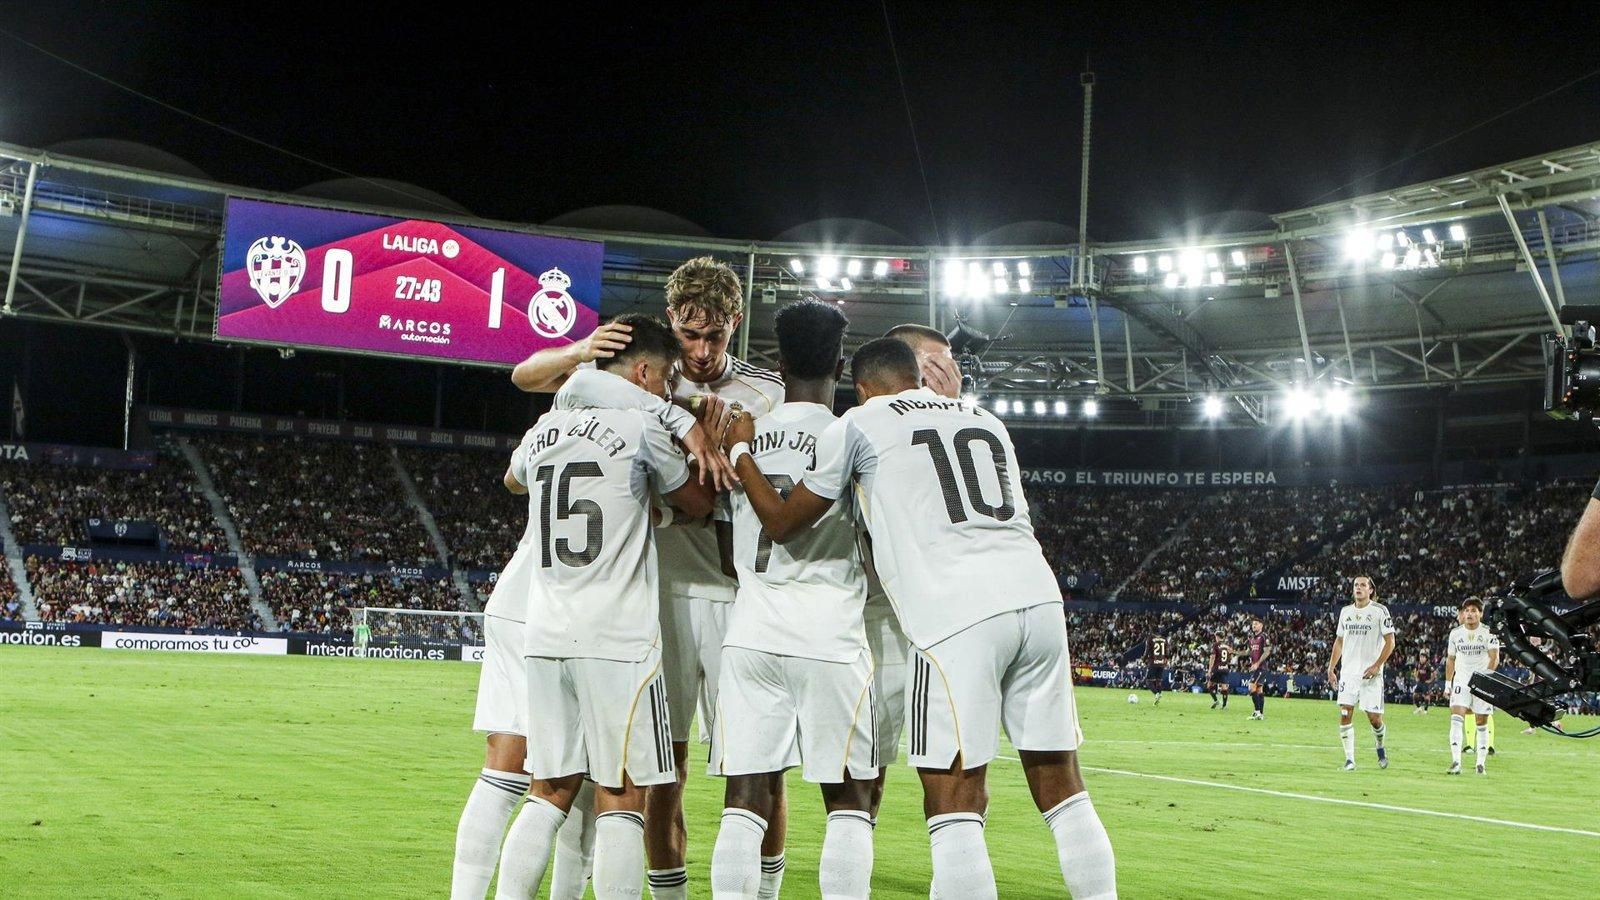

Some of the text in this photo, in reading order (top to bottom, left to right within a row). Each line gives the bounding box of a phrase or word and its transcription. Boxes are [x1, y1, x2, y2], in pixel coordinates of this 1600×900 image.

[383, 233, 438, 255] LALIGA
[321, 248, 353, 313] 0
[395, 275, 441, 303] 27:43
[488, 267, 505, 329] 1
[379, 314, 451, 335] MARCOS
[401, 332, 450, 345] automoción
[0, 445, 29, 460] TA
[911, 427, 1015, 524] 10
[1075, 471, 1096, 484] EL
[1102, 472, 1179, 485] TRIUNFO
[1184, 472, 1205, 485] TE
[1211, 471, 1276, 485] ESPERA
[536, 461, 604, 568] 15
[115, 638, 208, 650] compramos
[213, 638, 229, 650] tu
[1153, 642, 1165, 656] 21
[1221, 649, 1228, 662] 9
